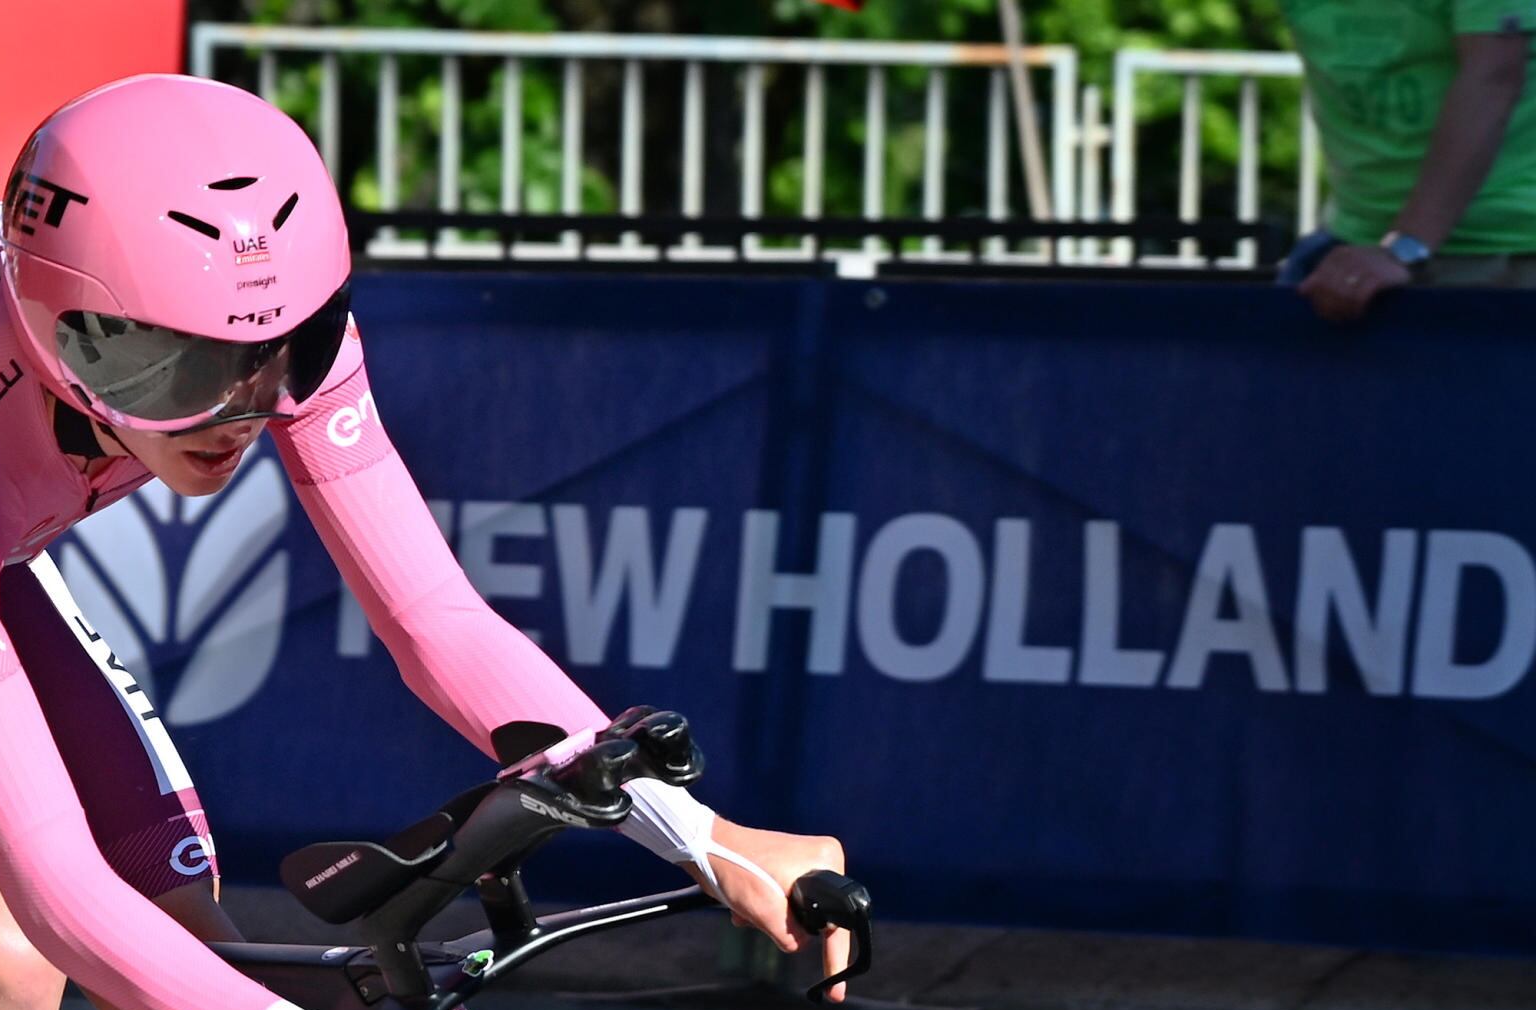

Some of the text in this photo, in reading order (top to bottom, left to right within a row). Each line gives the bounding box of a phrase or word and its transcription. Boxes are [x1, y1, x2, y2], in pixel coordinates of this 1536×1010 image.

[232, 235, 269, 254] UAE
[227, 305, 286, 326] MET
[336, 498, 710, 670] EW
[732, 509, 1536, 701] HOLLAND
